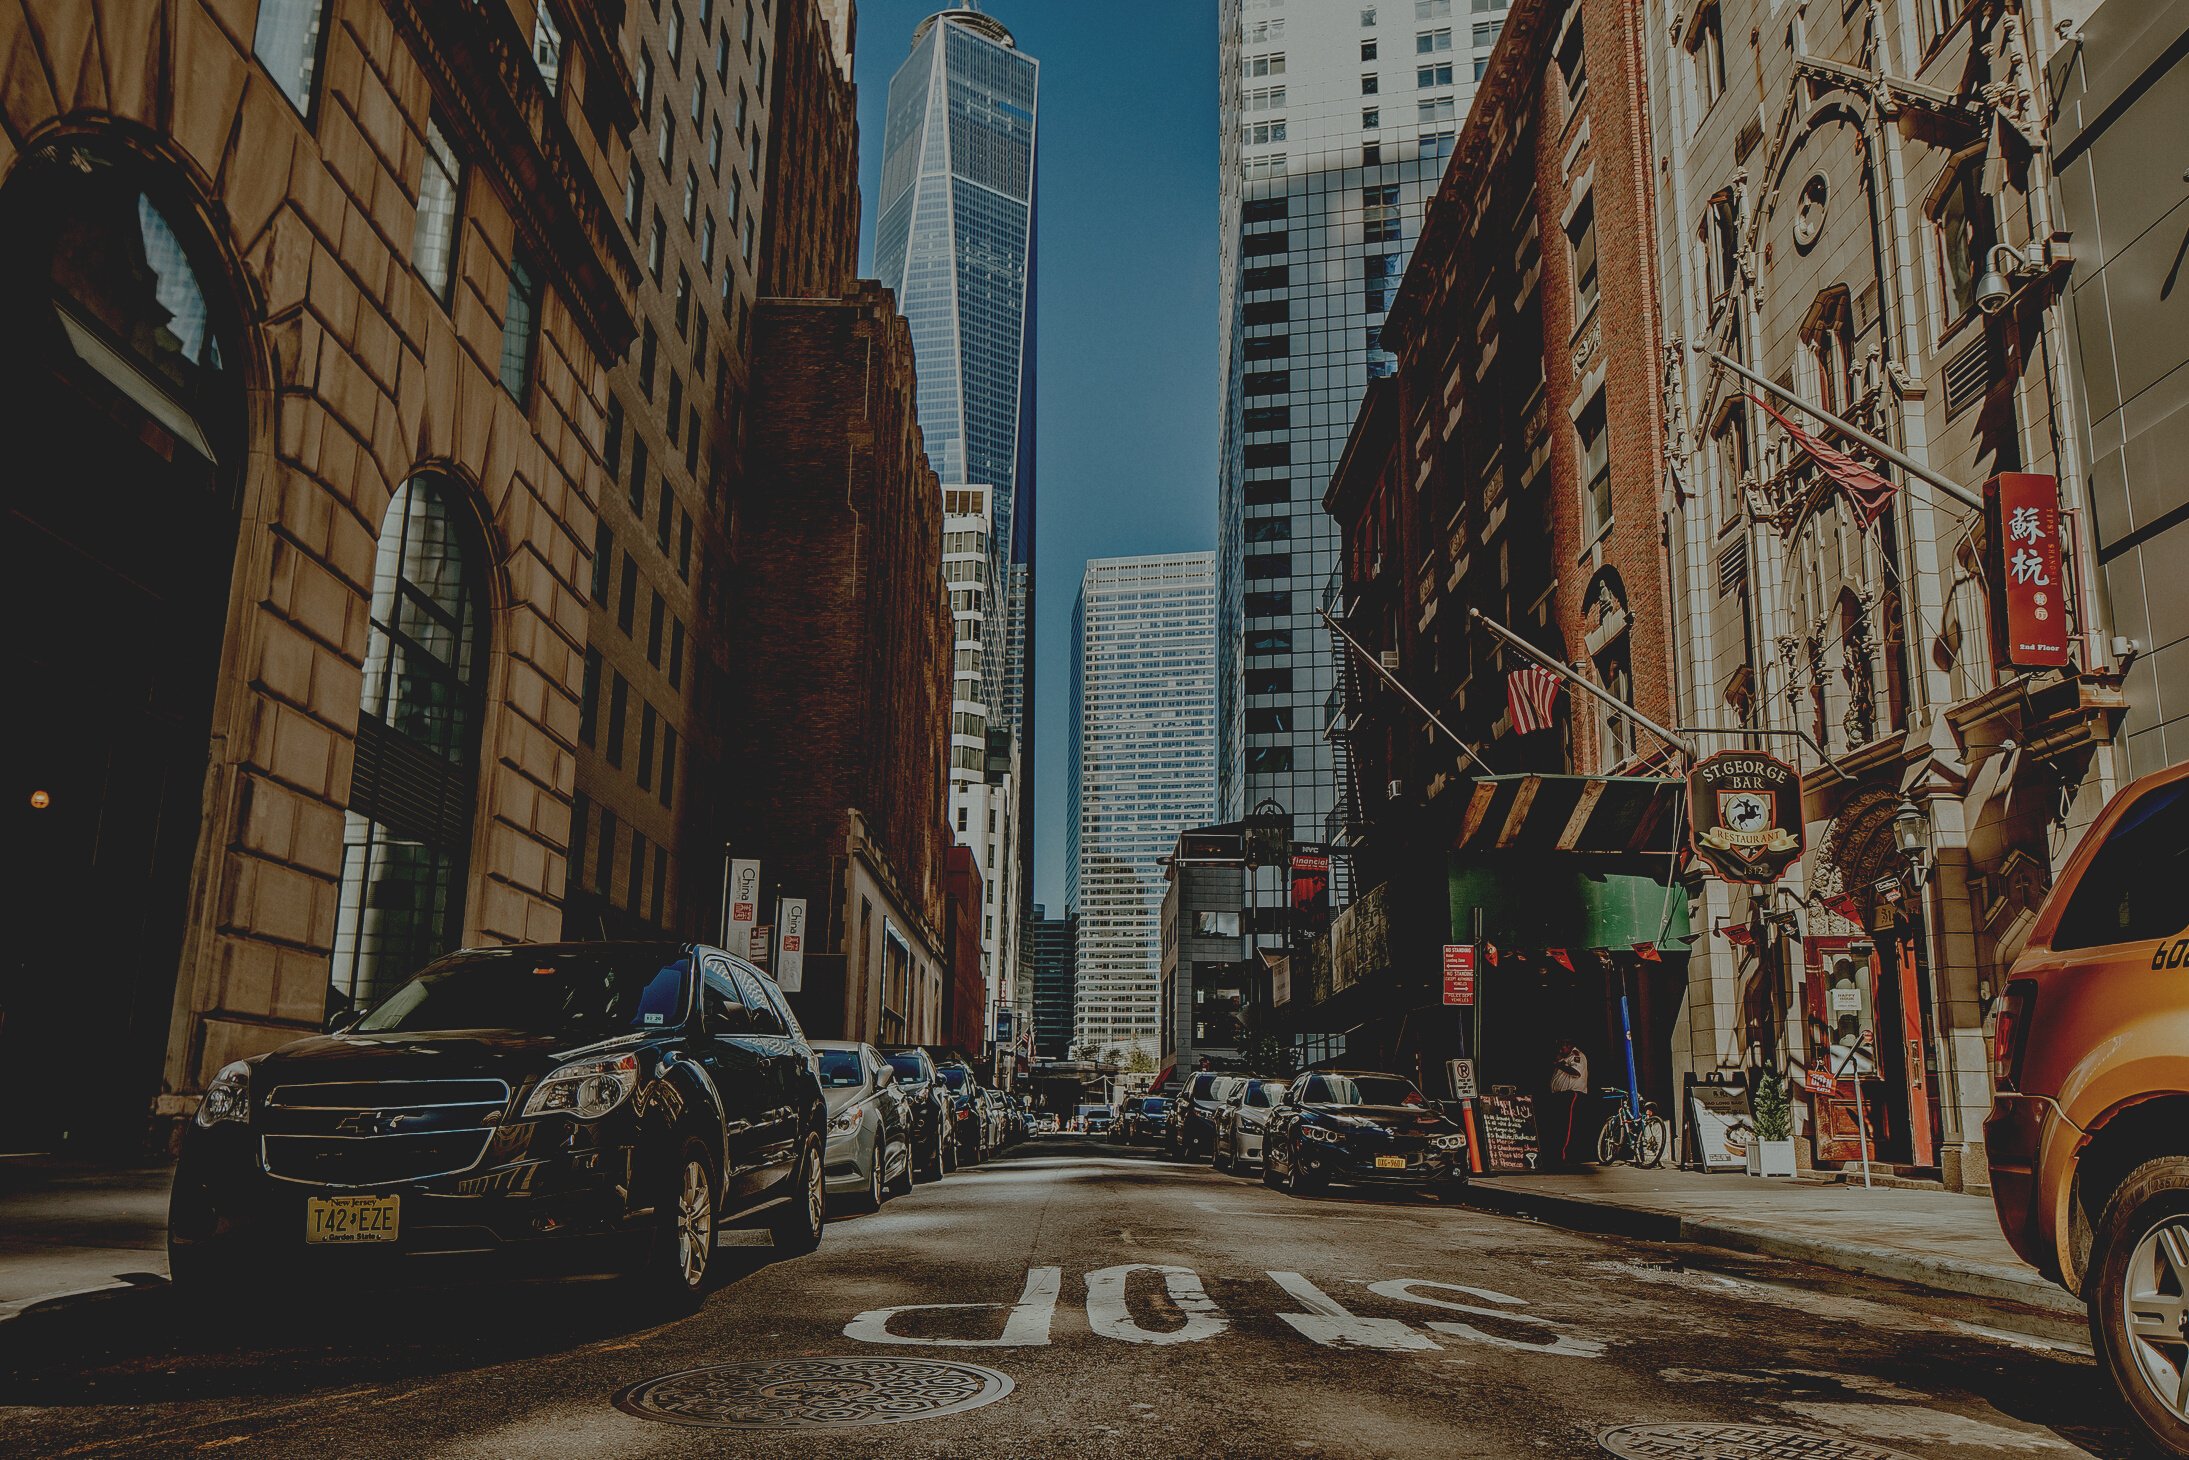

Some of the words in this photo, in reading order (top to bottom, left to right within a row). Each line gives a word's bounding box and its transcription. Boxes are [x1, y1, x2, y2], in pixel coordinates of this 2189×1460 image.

[2046, 508, 2055, 535] TIPSY
[2037, 644, 2060, 652] Floor
[1733, 776, 1764, 789] BAR
[1716, 829, 1781, 844] RESTAURANT
[1292, 856, 1328, 866] financial
[741, 867, 756, 901] China
[790, 905, 803, 934] China
[2151, 939, 2189, 970] 60
[331, 1199, 351, 1207] New
[351, 1198, 377, 1208] Jersey
[314, 1208, 348, 1233] T42
[358, 1206, 394, 1232] EZE
[328, 1233, 355, 1241] Garden
[842, 1263, 1608, 1360] STOP
